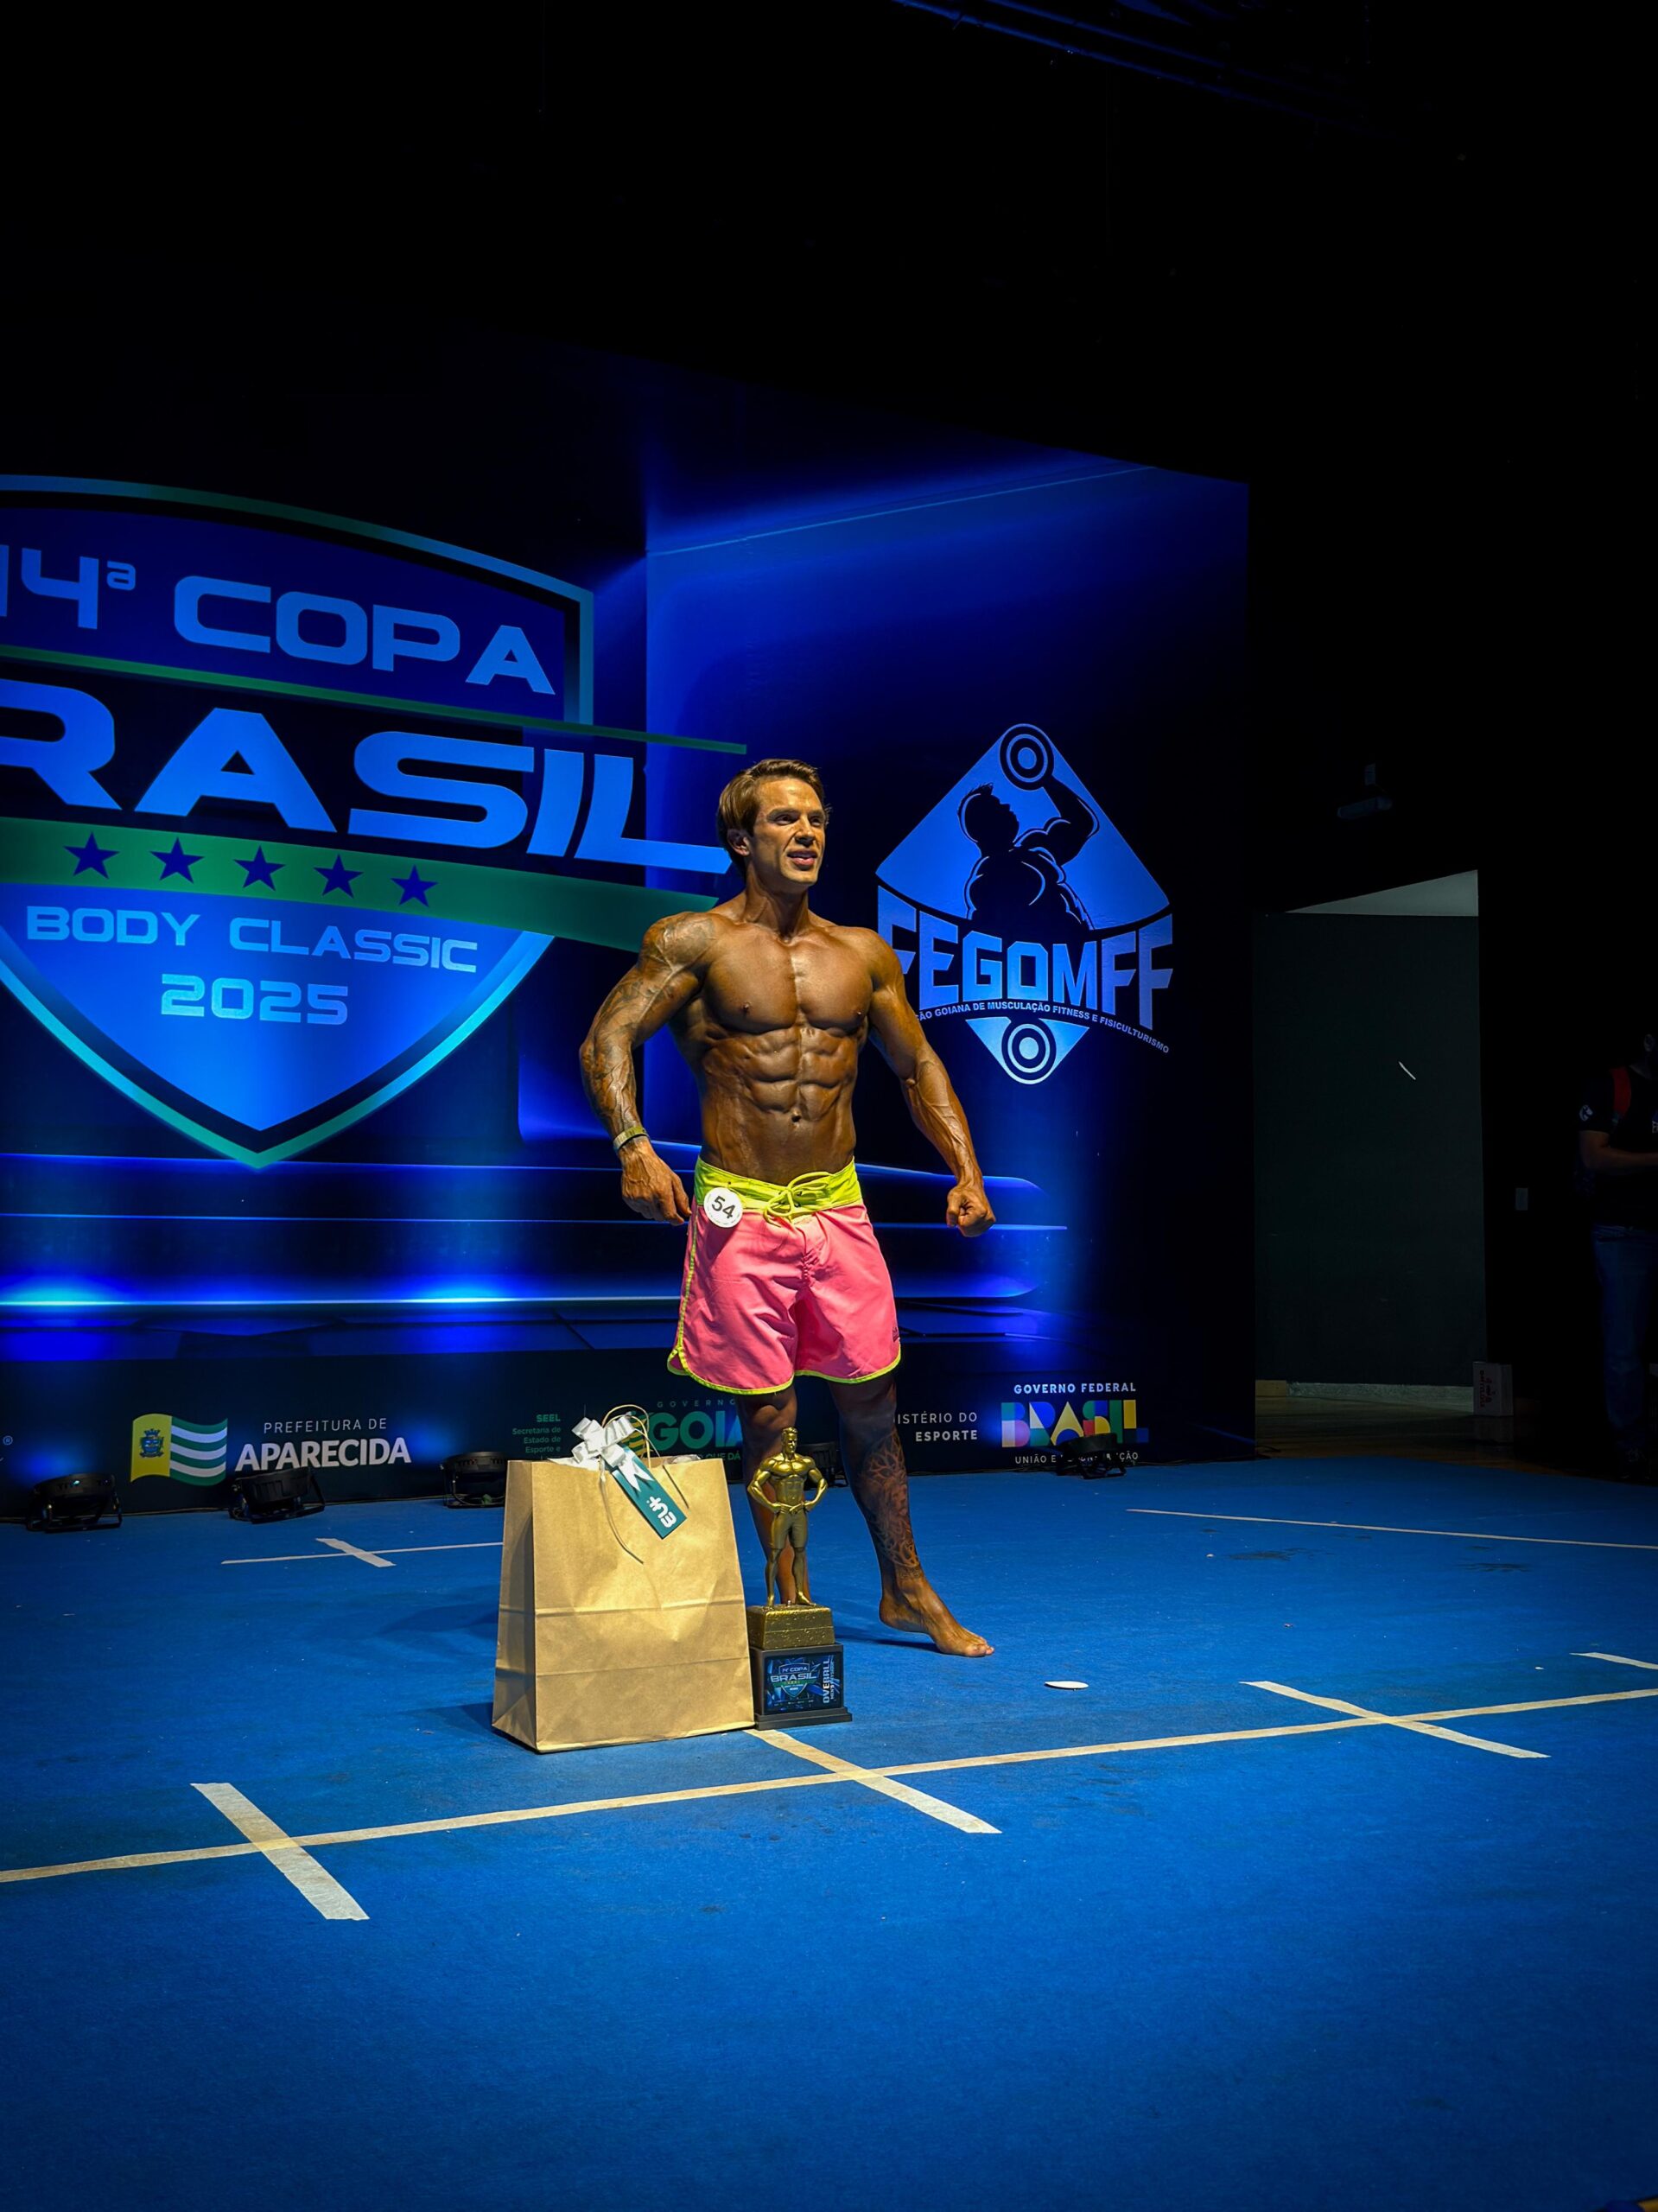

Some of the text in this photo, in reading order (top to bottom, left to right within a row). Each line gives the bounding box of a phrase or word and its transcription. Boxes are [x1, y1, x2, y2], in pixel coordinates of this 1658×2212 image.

[175, 575, 556, 696] COPA
[0, 678, 734, 874] RASIL
[27, 905, 478, 974] BODY CLASSIC
[877, 885, 1173, 1031] FEGOMFF
[161, 974, 349, 1026] 2025
[934, 1003, 970, 1017] GOIANA
[972, 1002, 986, 1011] DE
[987, 1001, 1051, 1013] MUSCULAÇÃO
[1052, 1005, 1090, 1020] FITNESS
[1091, 1014, 1098, 1022] E
[1100, 1016, 1170, 1054] FISICULTURISMO
[711, 1195, 736, 1219] 54
[1013, 1382, 1137, 1395] GOVERNO FEDERAL
[264, 1417, 387, 1433] PREFEITURA DE
[536, 1413, 561, 1423] SEEL
[895, 1410, 978, 1425] ISTÉRIO DO
[1001, 1398, 1150, 1448] BRASIL
[915, 1429, 978, 1442] ESPORTE
[234, 1436, 413, 1472] APARECIDA
[1014, 1453, 1048, 1465] UNIÃO
[1051, 1454, 1057, 1463] E
[770, 1673, 817, 1682] BRASIL
